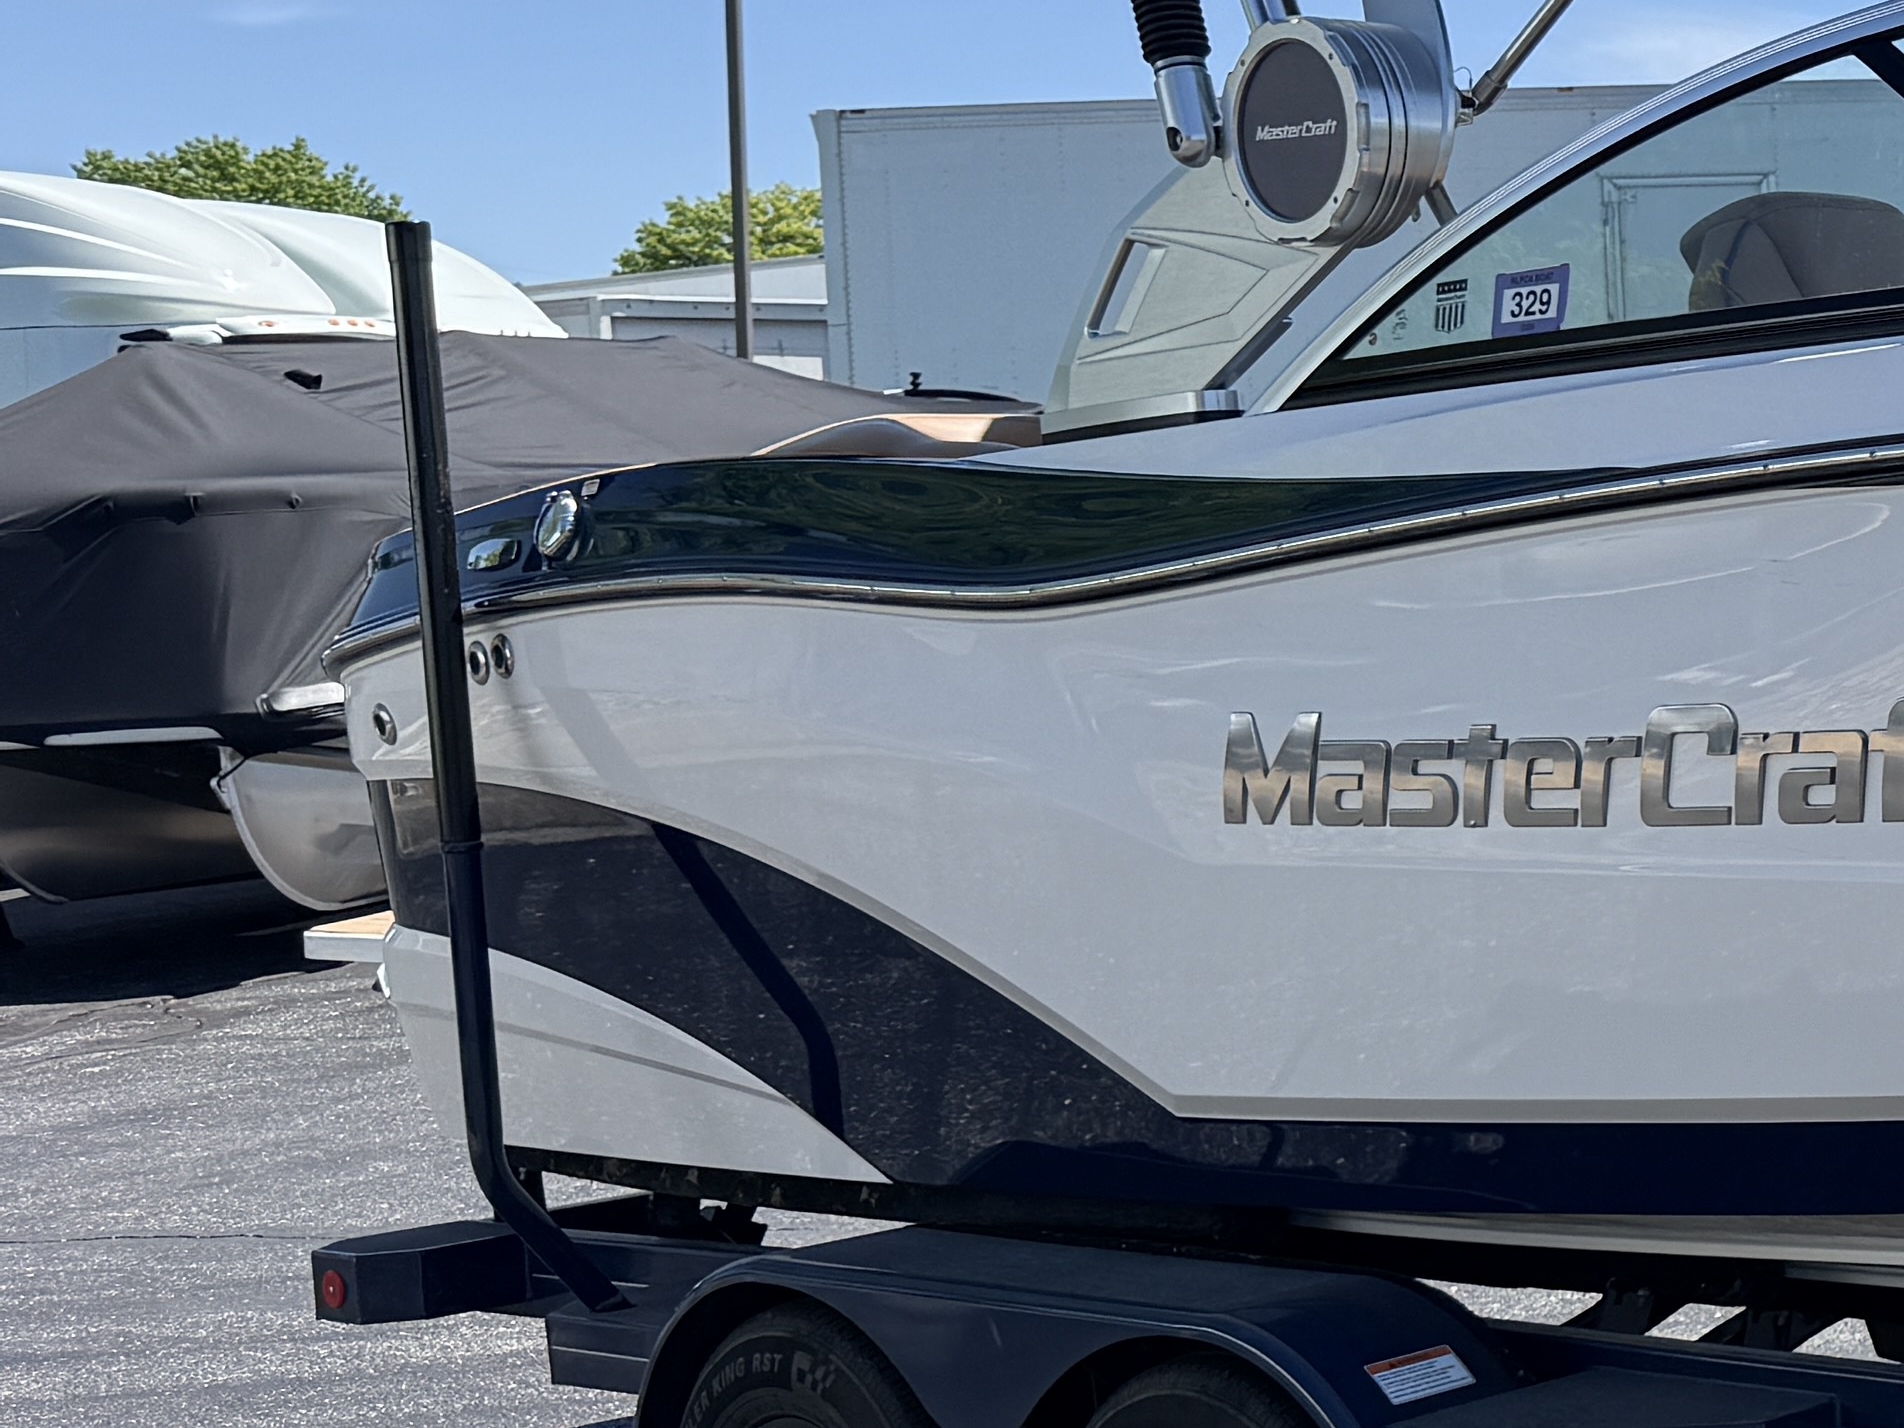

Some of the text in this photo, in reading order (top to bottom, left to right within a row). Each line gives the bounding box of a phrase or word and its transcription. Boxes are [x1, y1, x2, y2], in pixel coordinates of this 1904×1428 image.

[1255, 118, 1338, 142] MasterCraft
[1510, 288, 1552, 318] 329
[712, 1356, 746, 1398] KING
[751, 1352, 784, 1373] RST
